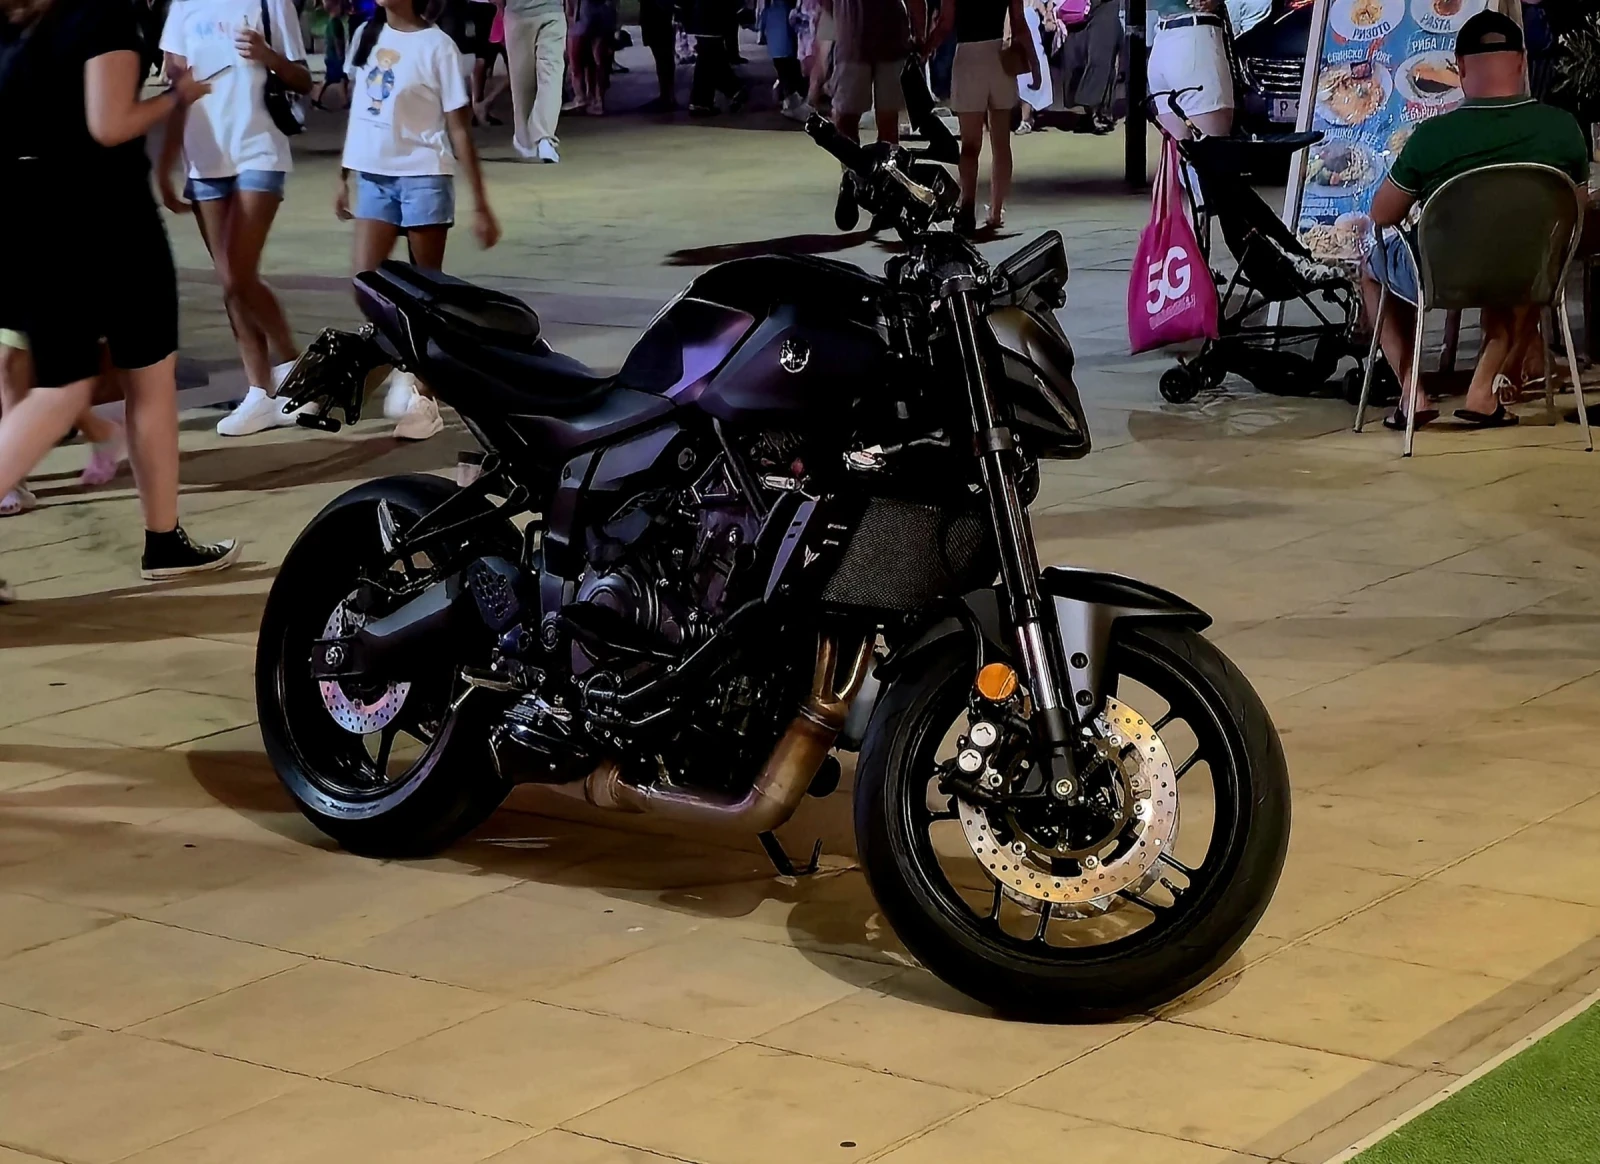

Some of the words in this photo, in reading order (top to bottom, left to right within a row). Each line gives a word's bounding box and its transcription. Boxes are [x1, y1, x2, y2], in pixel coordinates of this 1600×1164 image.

[1352, 21, 1391, 40] РИЗОТО
[1420, 14, 1451, 30] PASTA
[1412, 37, 1437, 52] РИБА
[1146, 246, 1191, 314] 5G
